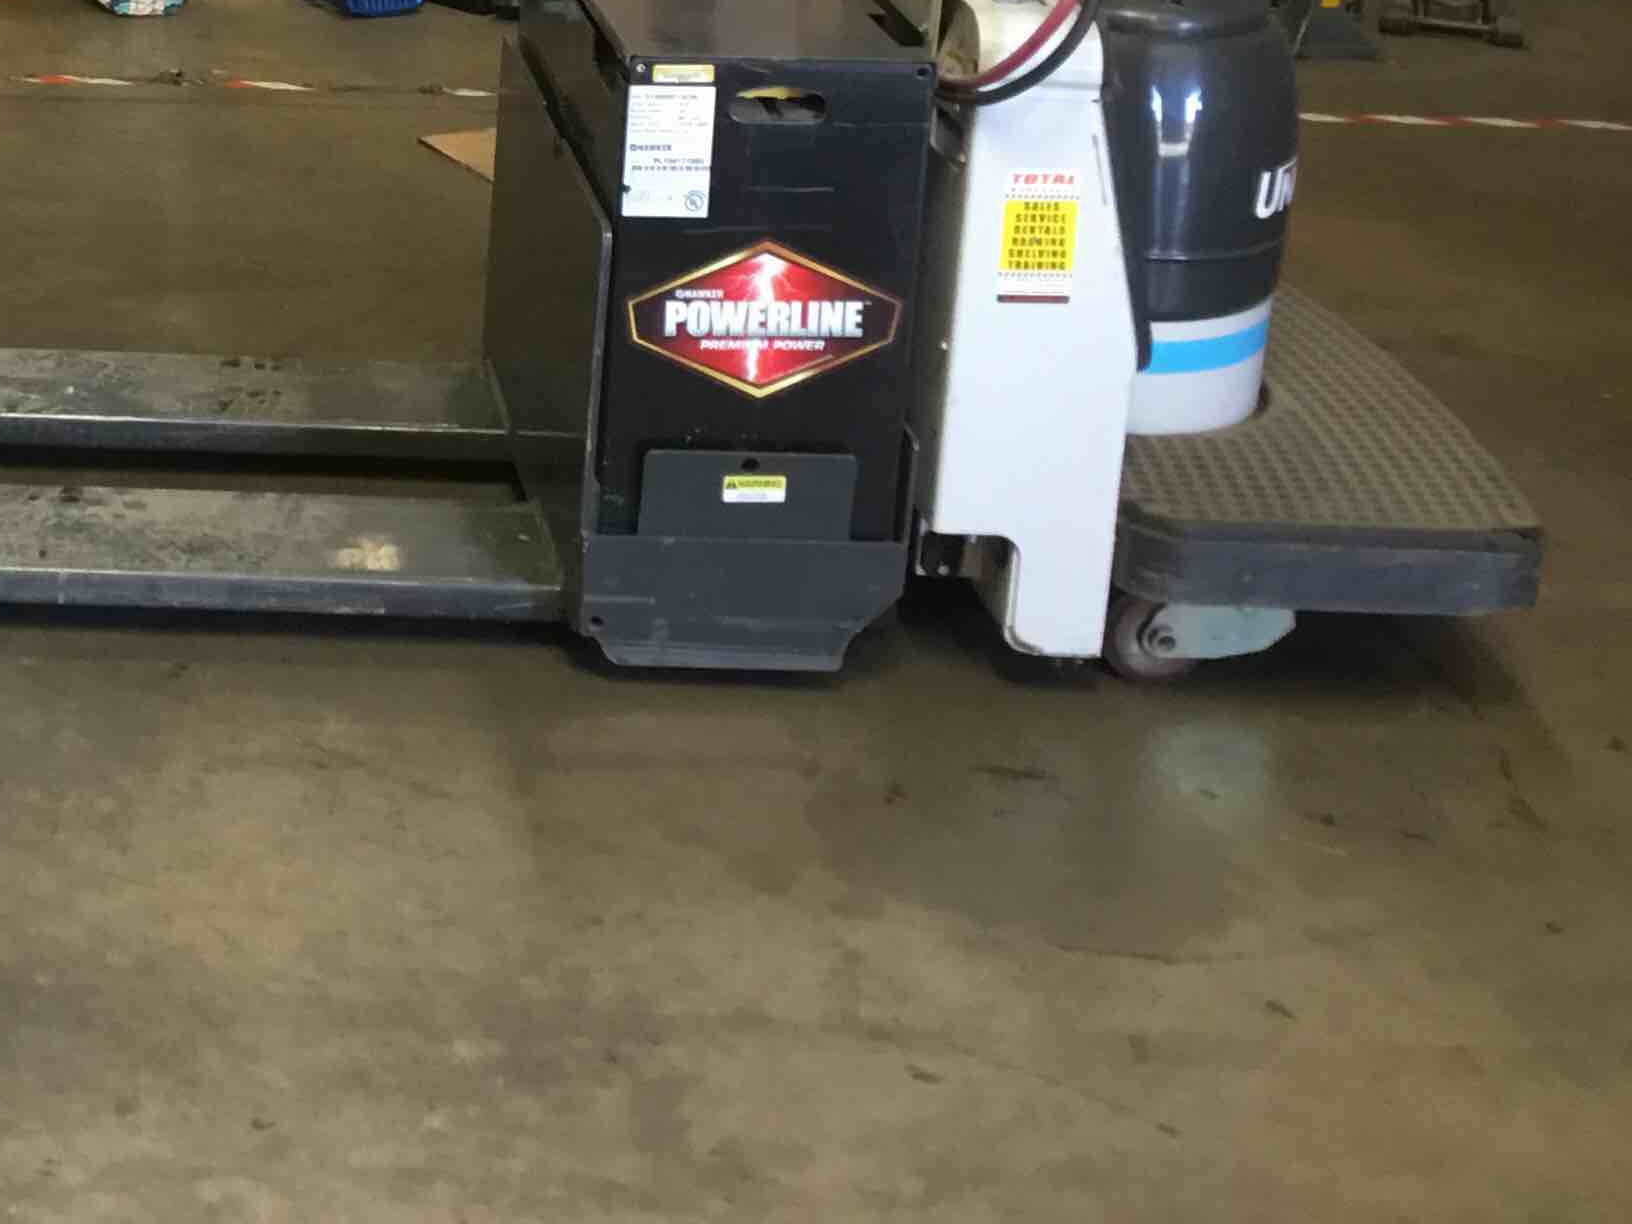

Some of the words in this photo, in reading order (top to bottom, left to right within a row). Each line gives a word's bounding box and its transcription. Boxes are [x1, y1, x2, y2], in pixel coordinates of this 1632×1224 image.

[1015, 213, 1067, 223] SERVICE
[1008, 260, 1065, 271] TRAINING
[664, 300, 864, 338] POWERLINE
[699, 339, 769, 351] PREMIUM
[773, 339, 826, 352] POWER
